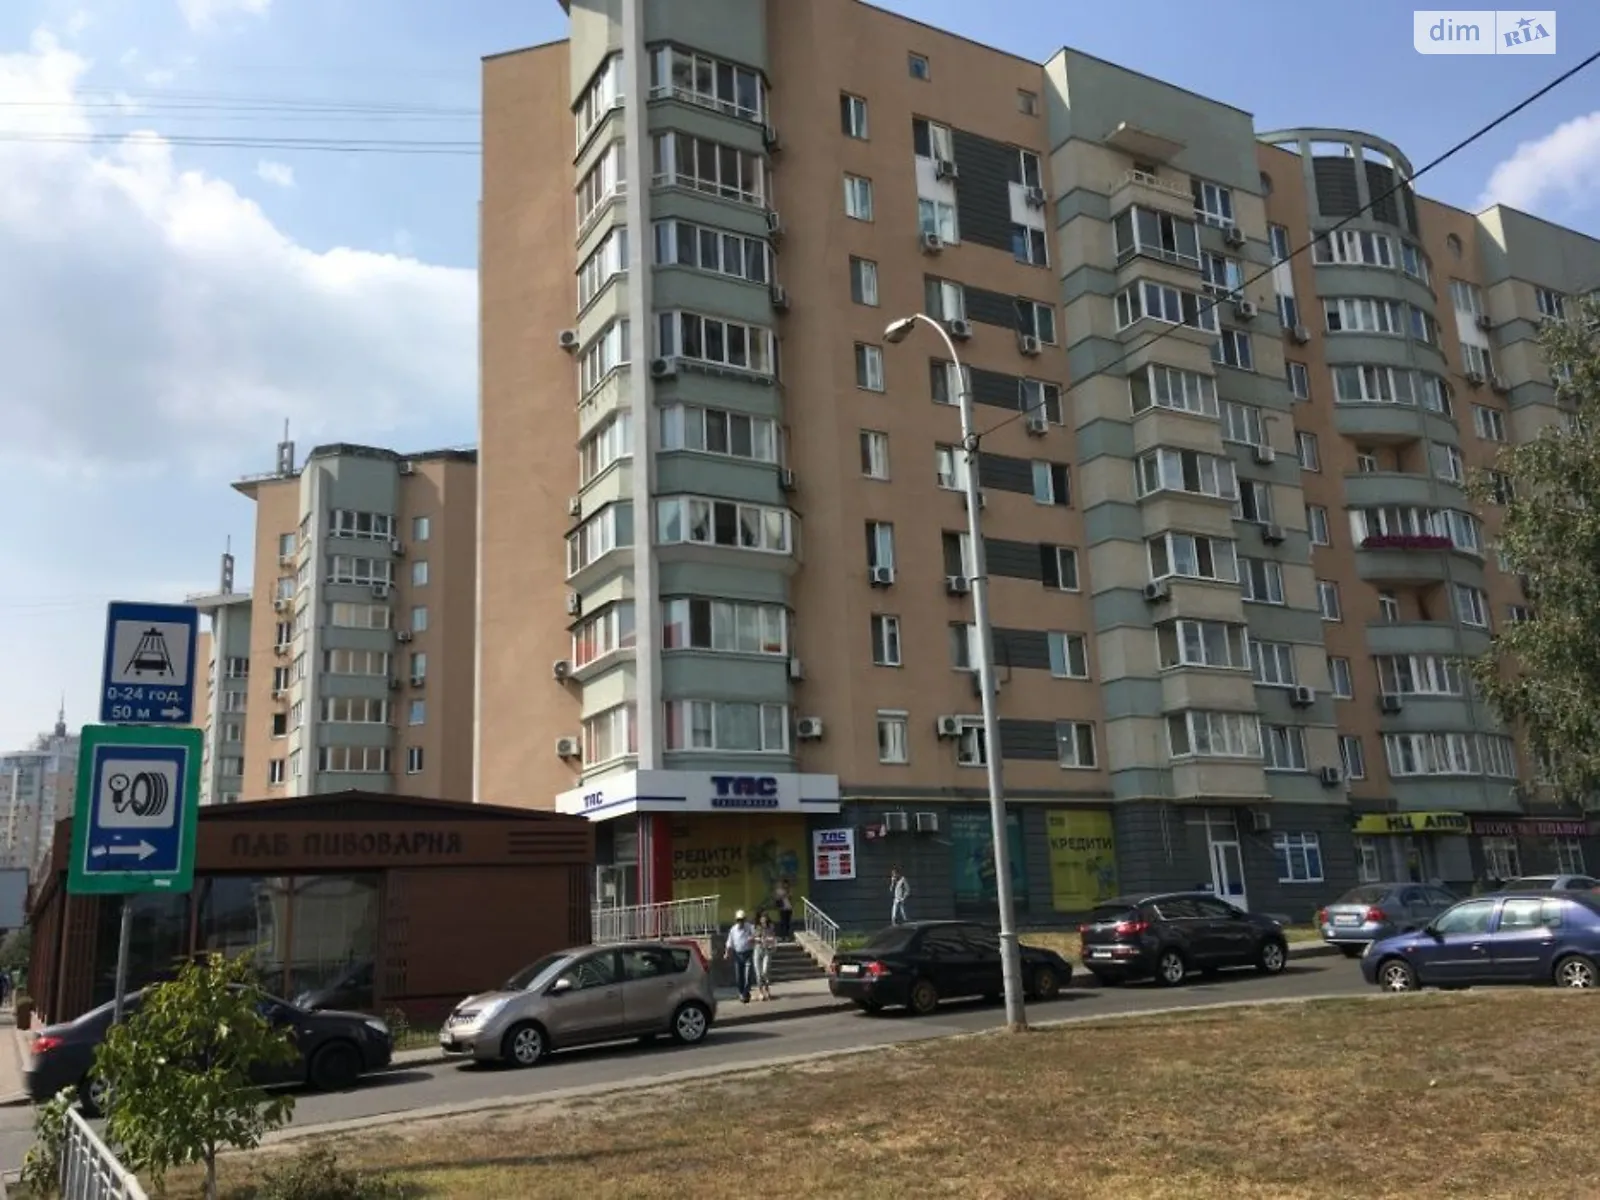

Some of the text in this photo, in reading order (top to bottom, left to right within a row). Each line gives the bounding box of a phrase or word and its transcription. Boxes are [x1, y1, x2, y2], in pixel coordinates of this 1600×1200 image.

[107, 687, 143, 700] 0-24
[112, 705, 132, 718] 50
[230, 831, 463, 859] ПАБ ПИВОВАРНЯ
[1050, 837, 1112, 851] КРЕДИТИ
[673, 847, 742, 863] РЕДИТИ
